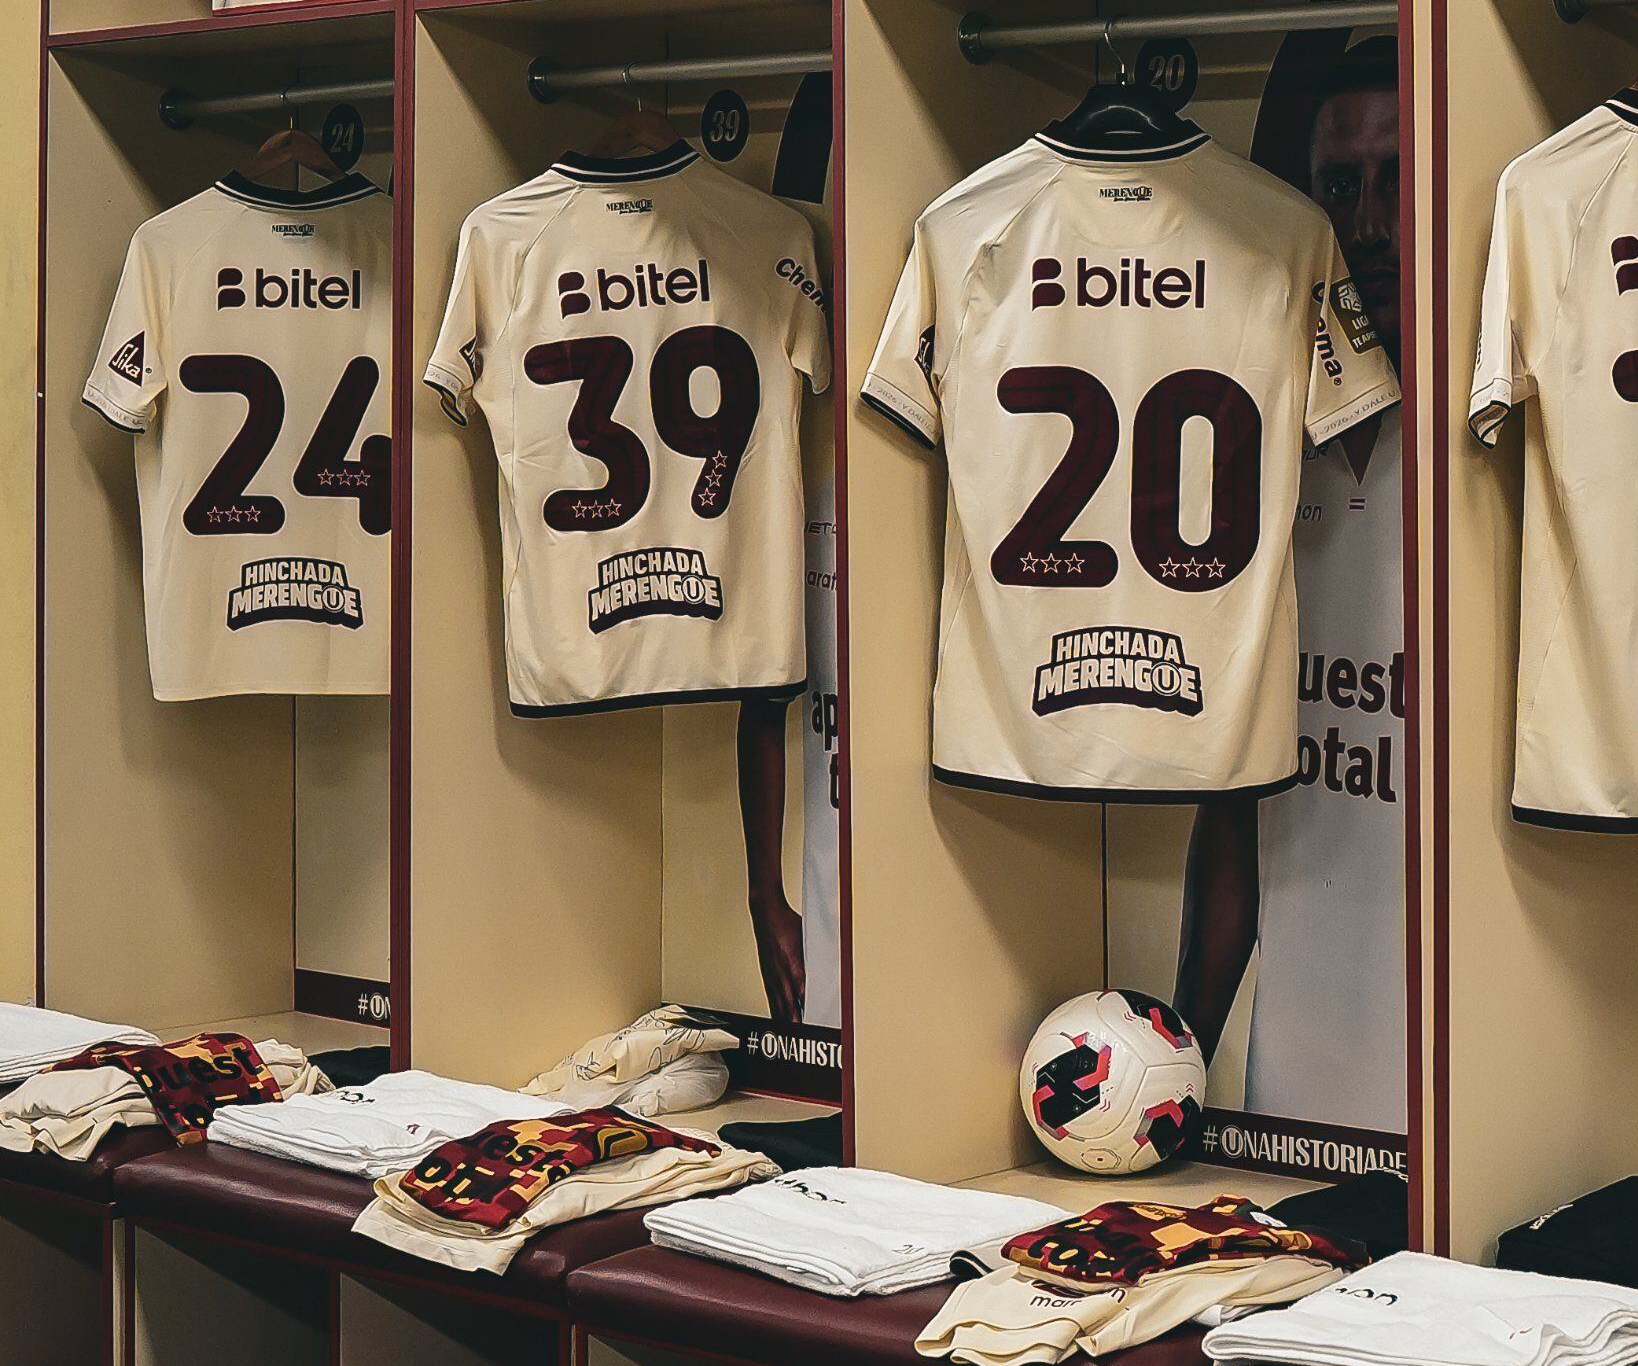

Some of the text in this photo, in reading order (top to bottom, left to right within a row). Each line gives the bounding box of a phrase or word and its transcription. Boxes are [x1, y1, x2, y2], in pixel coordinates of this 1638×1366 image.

[1148, 54, 1186, 92] 20
[256, 268, 361, 310] bitel
[599, 259, 711, 312] bitel
[1076, 257, 1206, 309] bitel
[179, 354, 393, 536] 24
[523, 325, 761, 532] 39
[990, 365, 1263, 593] 20
[245, 557, 344, 586] HINCHADA
[602, 551, 702, 588] HINCHADA
[231, 583, 360, 620] MERENGUE
[591, 573, 721, 621] MERENGUE
[1055, 630, 1181, 665] HINCHADA
[1039, 660, 1197, 702] MERENGUE
